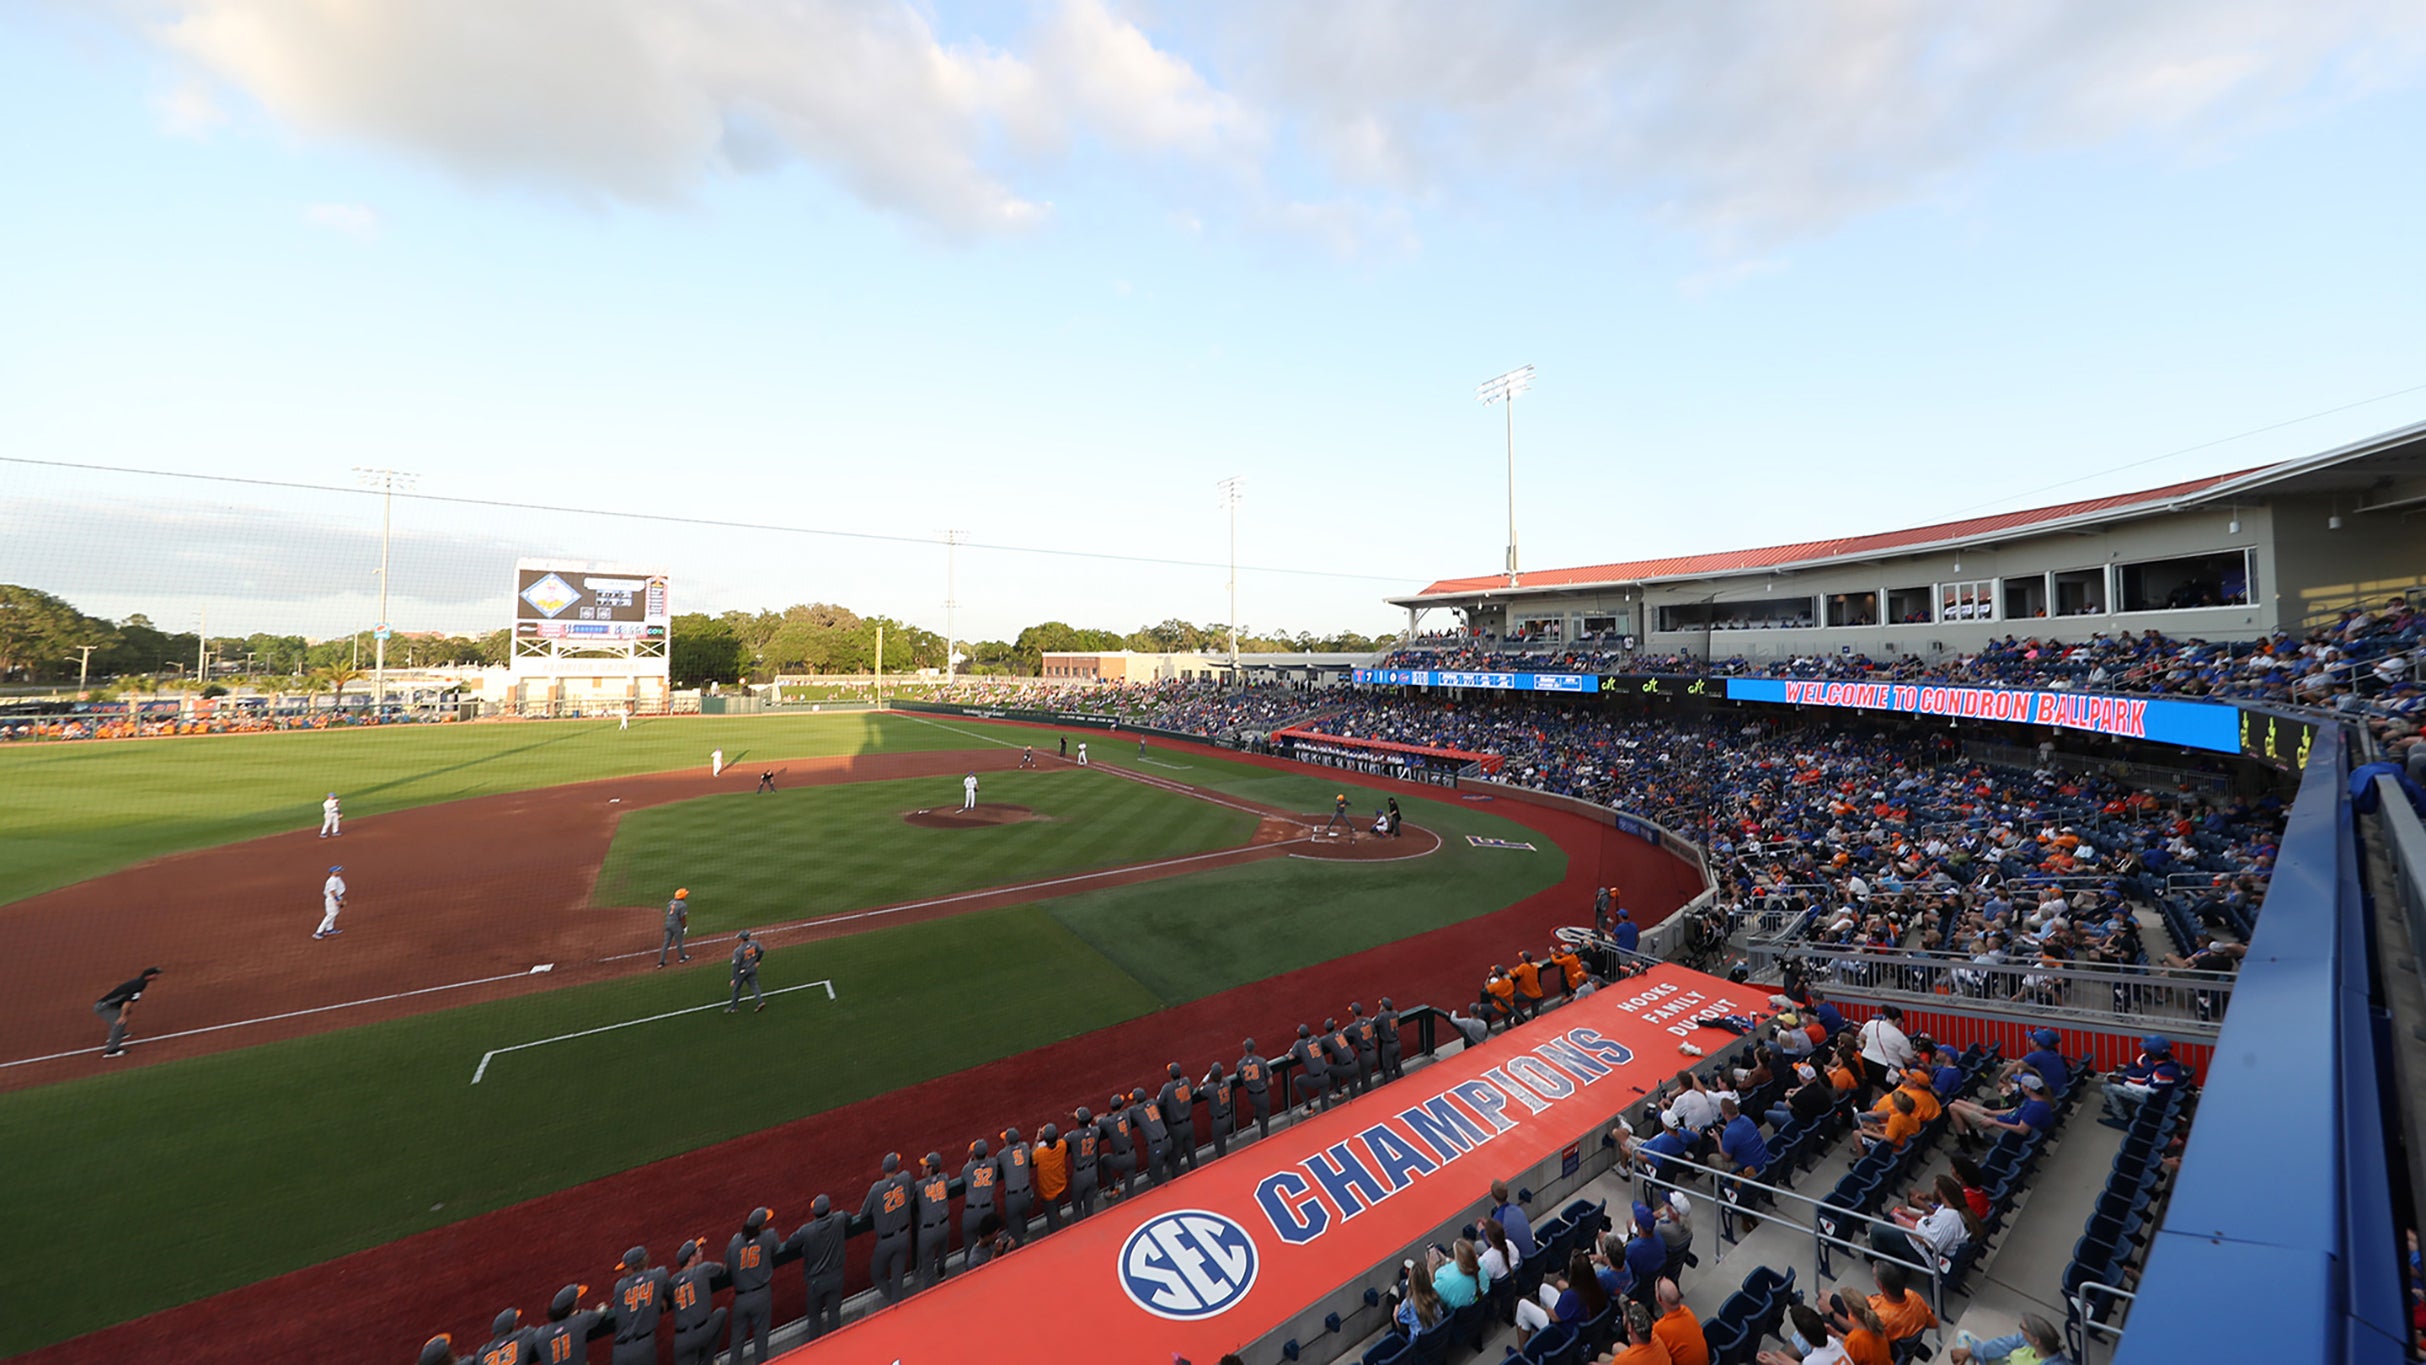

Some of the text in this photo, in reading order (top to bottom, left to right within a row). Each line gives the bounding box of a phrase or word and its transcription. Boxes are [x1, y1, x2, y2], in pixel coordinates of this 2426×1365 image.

[1785, 681, 2148, 737] WELCOME TO CONDRON BALLPARK
[1616, 983, 1679, 1013] HOOKS
[1641, 990, 1707, 1024] FAMILY
[1253, 1026, 1634, 1245] CHAMPIONS
[1012, 1149, 1025, 1166] 5
[924, 1180, 947, 1203] 48
[973, 1167, 993, 1188] 32
[739, 1245, 761, 1270] 16
[1128, 1216, 1248, 1311] SEC
[624, 1280, 655, 1312] 44
[673, 1281, 697, 1310] 41
[550, 1333, 571, 1365] 11
